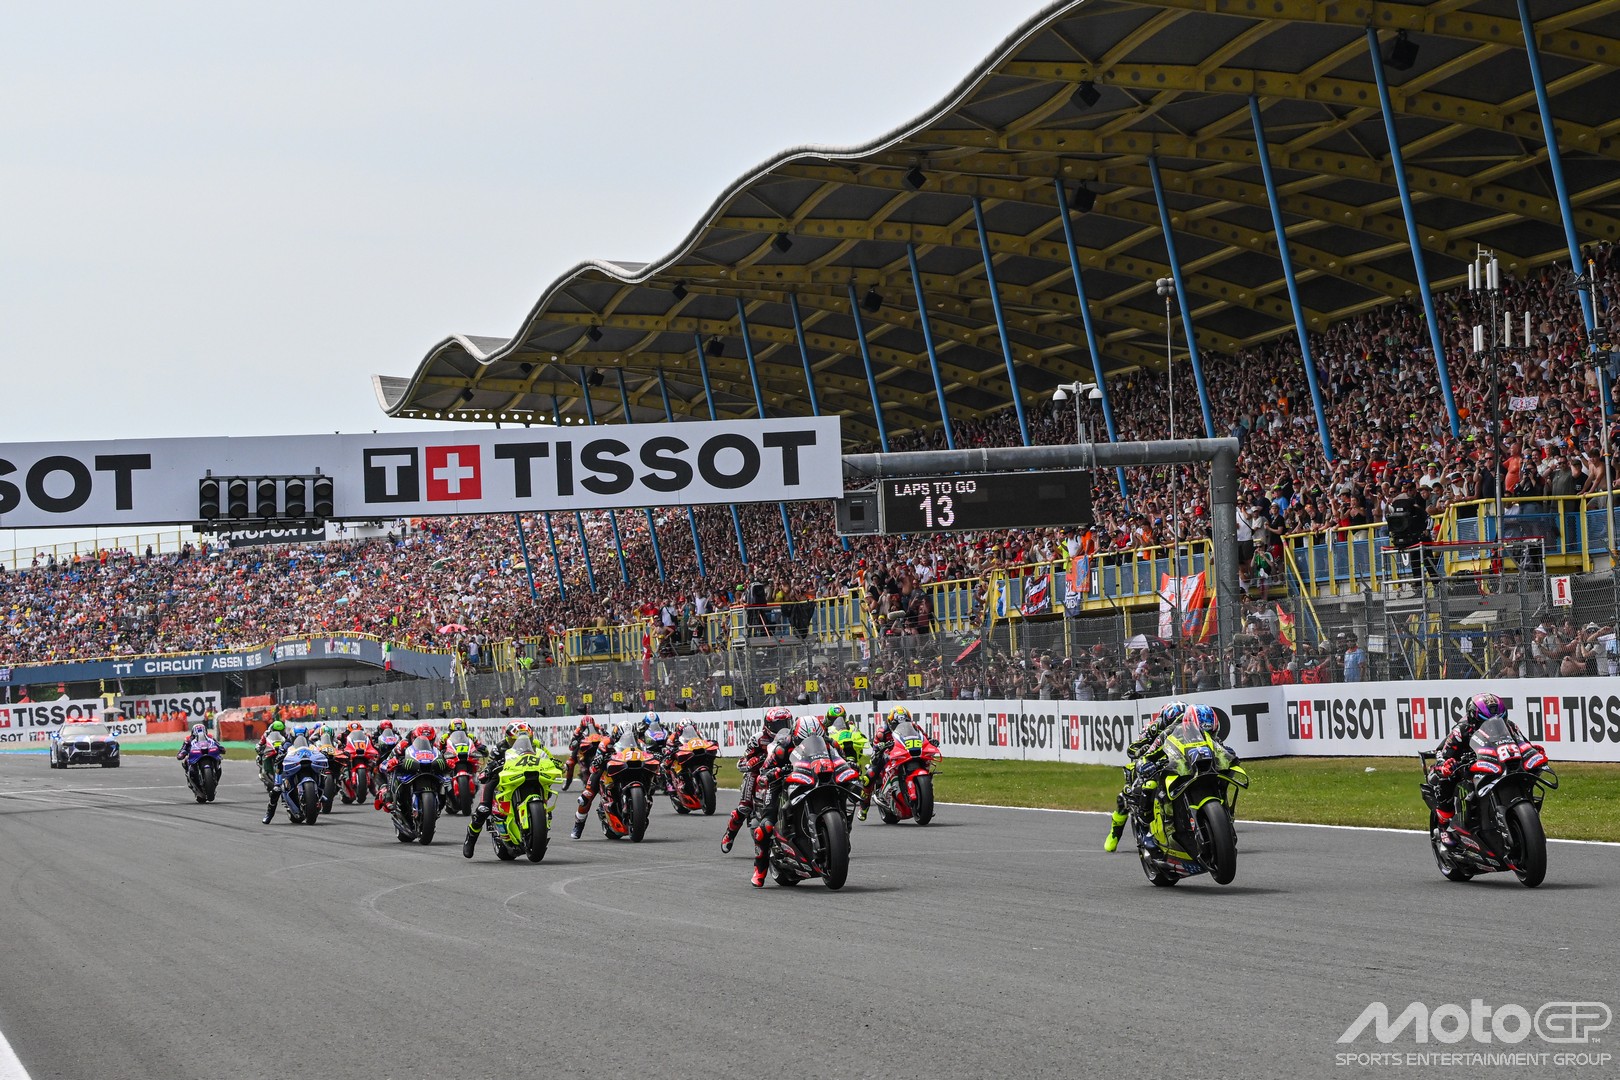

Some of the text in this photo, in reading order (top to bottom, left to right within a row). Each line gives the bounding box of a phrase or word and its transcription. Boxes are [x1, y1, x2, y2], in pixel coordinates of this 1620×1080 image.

[494, 430, 817, 498] TISSOT
[894, 480, 977, 497] LAPS TO GO
[919, 495, 955, 528] 13
[112, 663, 134, 675] TT
[144, 659, 204, 673] CIRCUIT
[211, 656, 243, 669] ASSEN
[13, 704, 97, 727] TISSOT
[152, 696, 216, 722] TISSOT
[1314, 699, 1386, 740] TISSOT
[734, 719, 762, 746] TISSOT
[940, 713, 982, 746] TISSOT
[1007, 714, 1055, 749] TISSOT
[1080, 715, 1134, 752] TISSOT
[352, 742, 366, 750] 10
[624, 750, 642, 761] 37
[690, 739, 704, 748] 23
[905, 740, 923, 750] 36
[515, 756, 541, 767] 49
